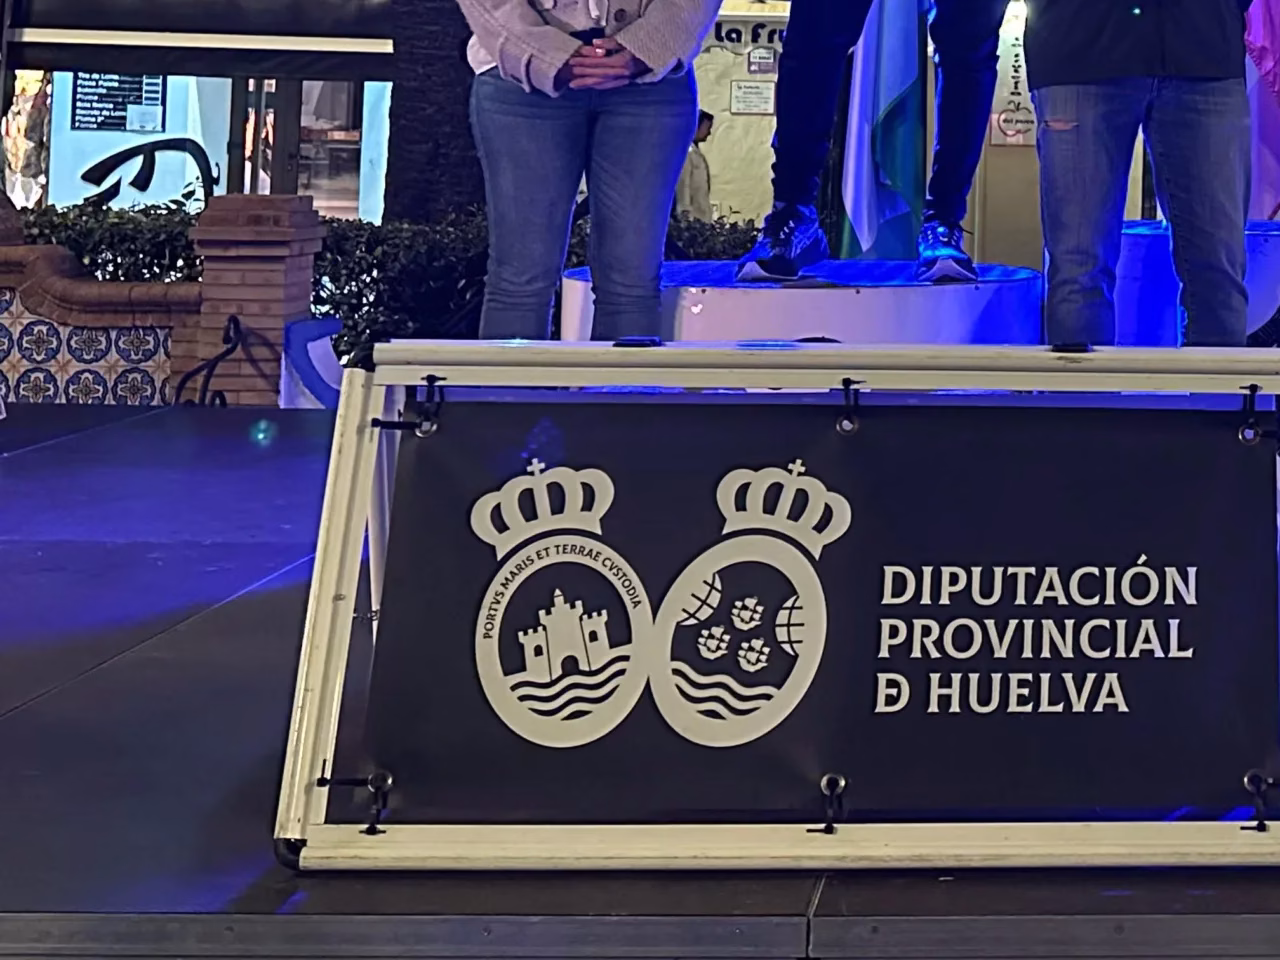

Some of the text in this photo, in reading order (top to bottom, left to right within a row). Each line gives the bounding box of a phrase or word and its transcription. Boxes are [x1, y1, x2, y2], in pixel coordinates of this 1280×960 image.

[483, 543, 642, 639] PORTVS MARIS ET TERRAE CVSTODIA
[881, 553, 1198, 607] DIPUTACIÓN
[877, 617, 1194, 659] PROVINCIAL
[927, 672, 1130, 714] HUELVA
